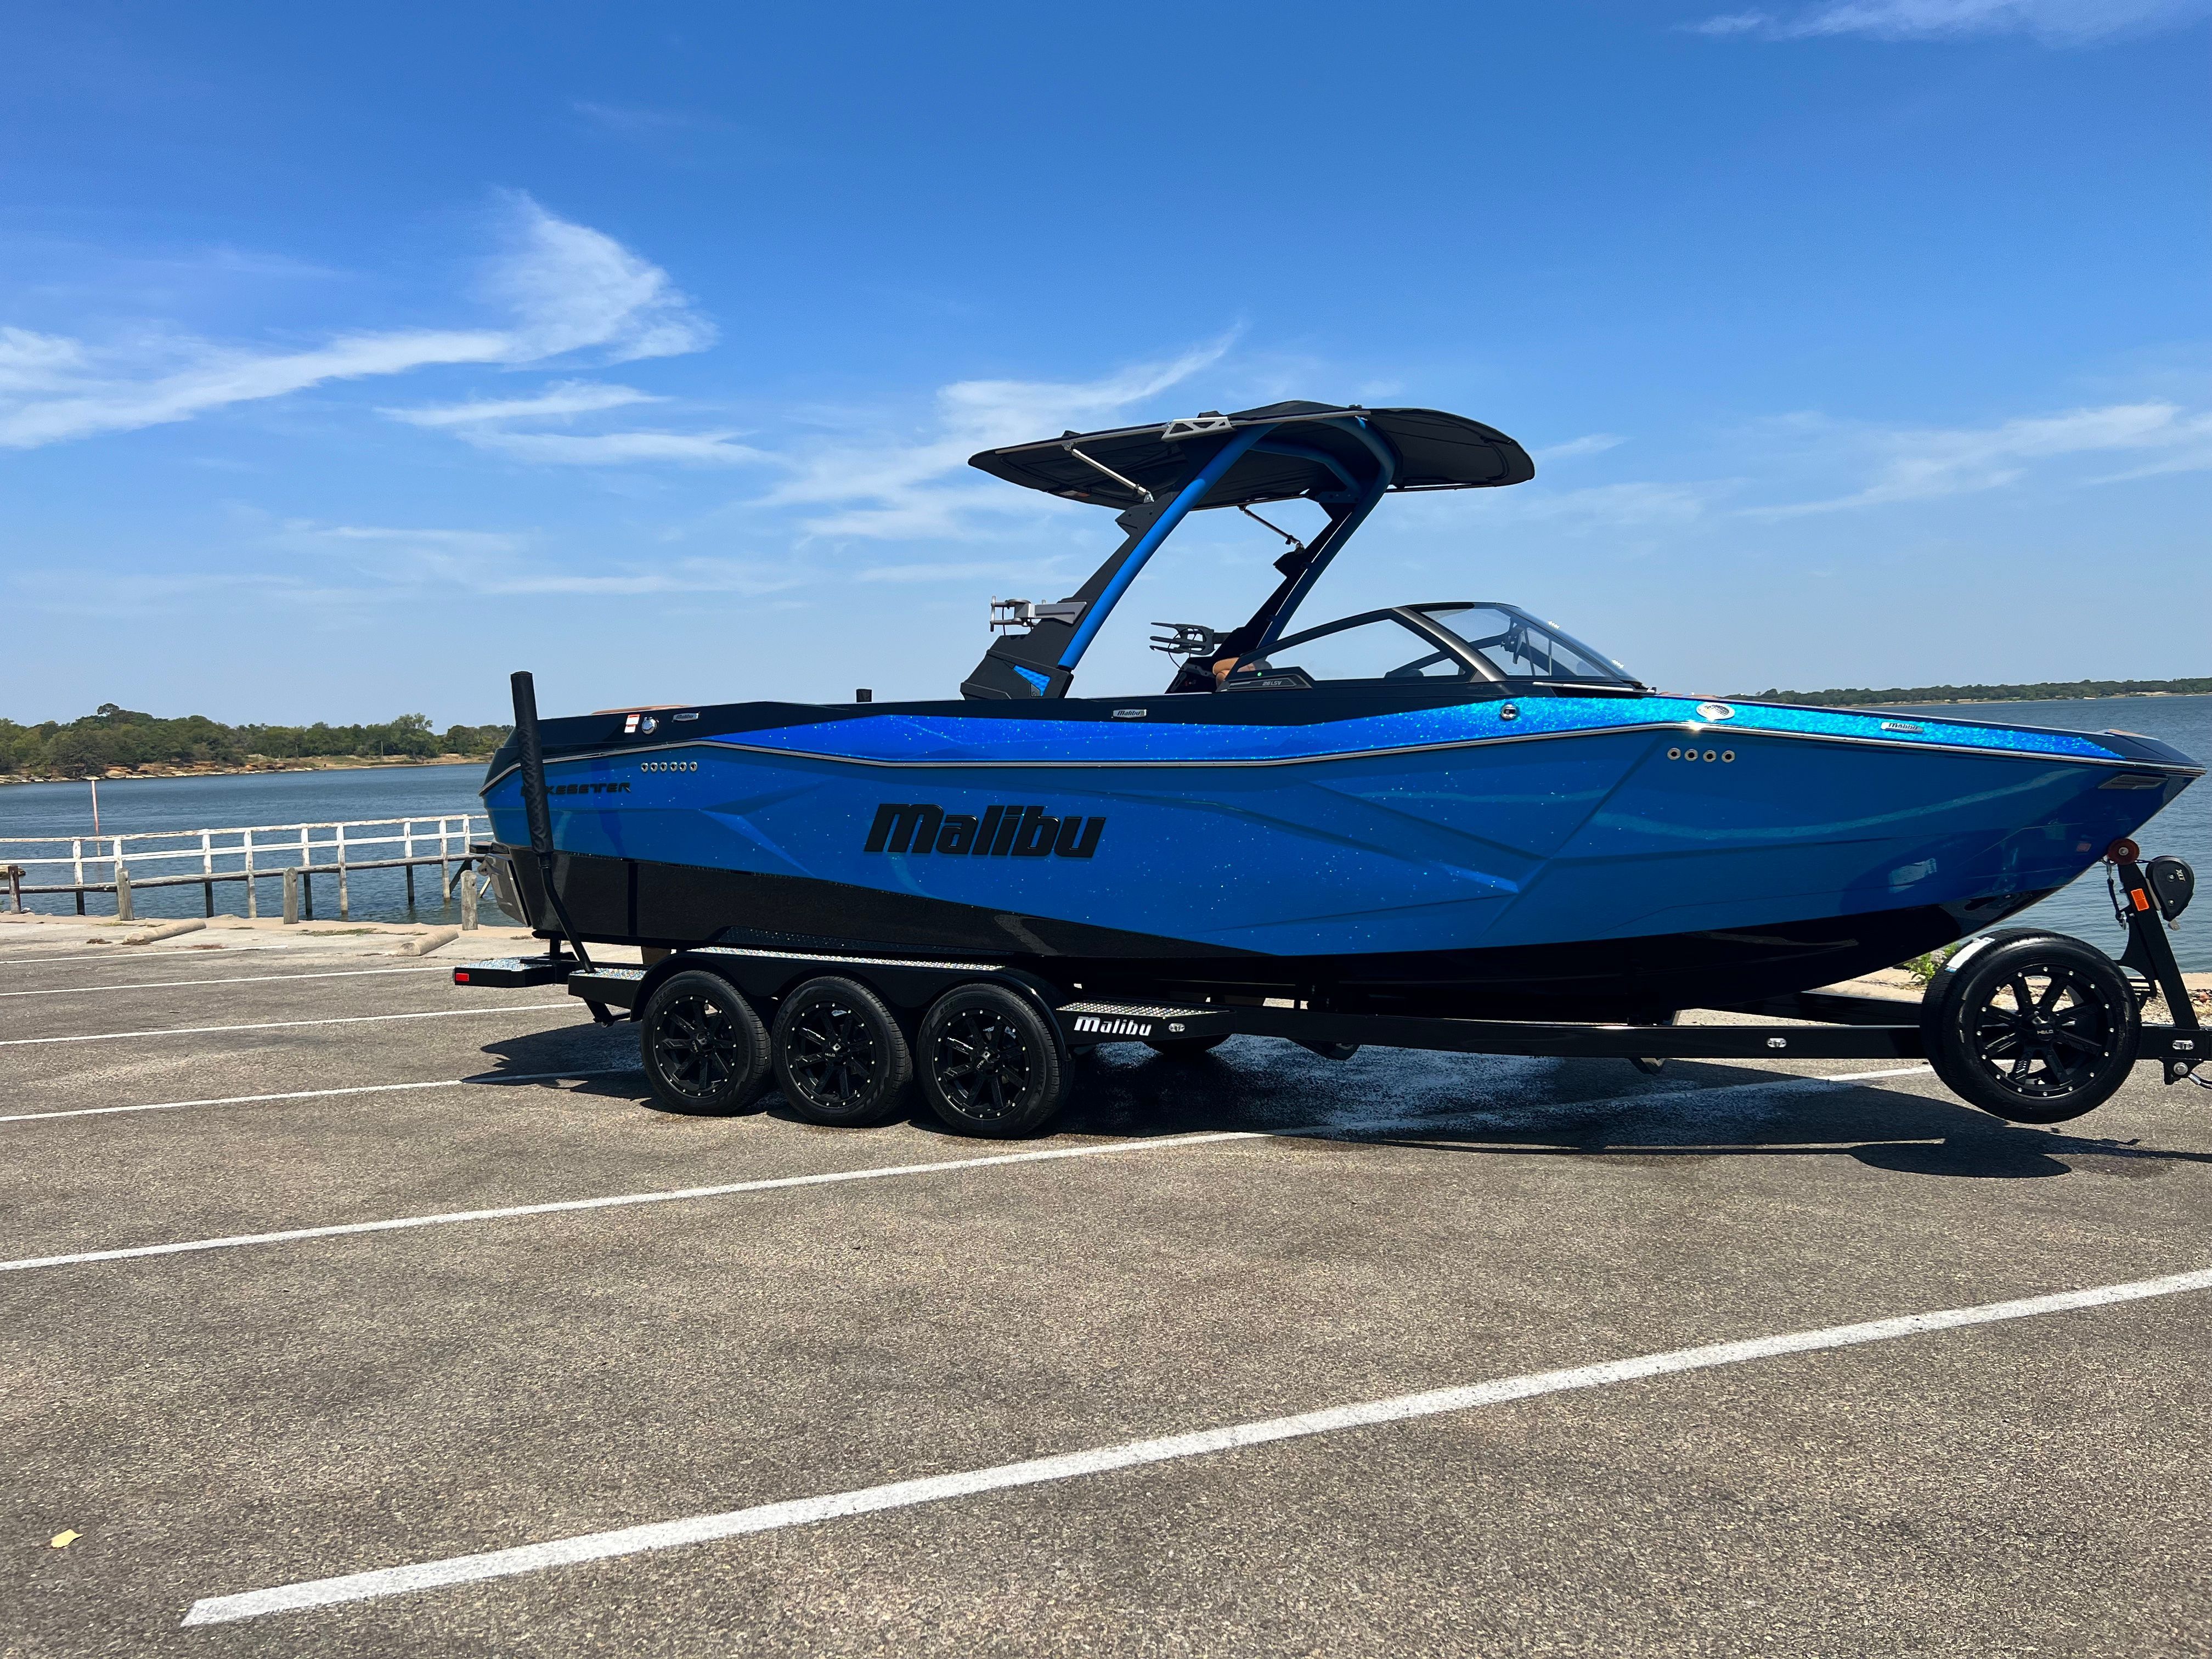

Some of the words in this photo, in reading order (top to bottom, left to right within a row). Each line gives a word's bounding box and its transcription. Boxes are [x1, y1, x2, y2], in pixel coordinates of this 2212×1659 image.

[521, 782, 631, 796] KESETTER
[864, 803, 1107, 858] Malibu
[1074, 1016, 1152, 1036] Malibu
